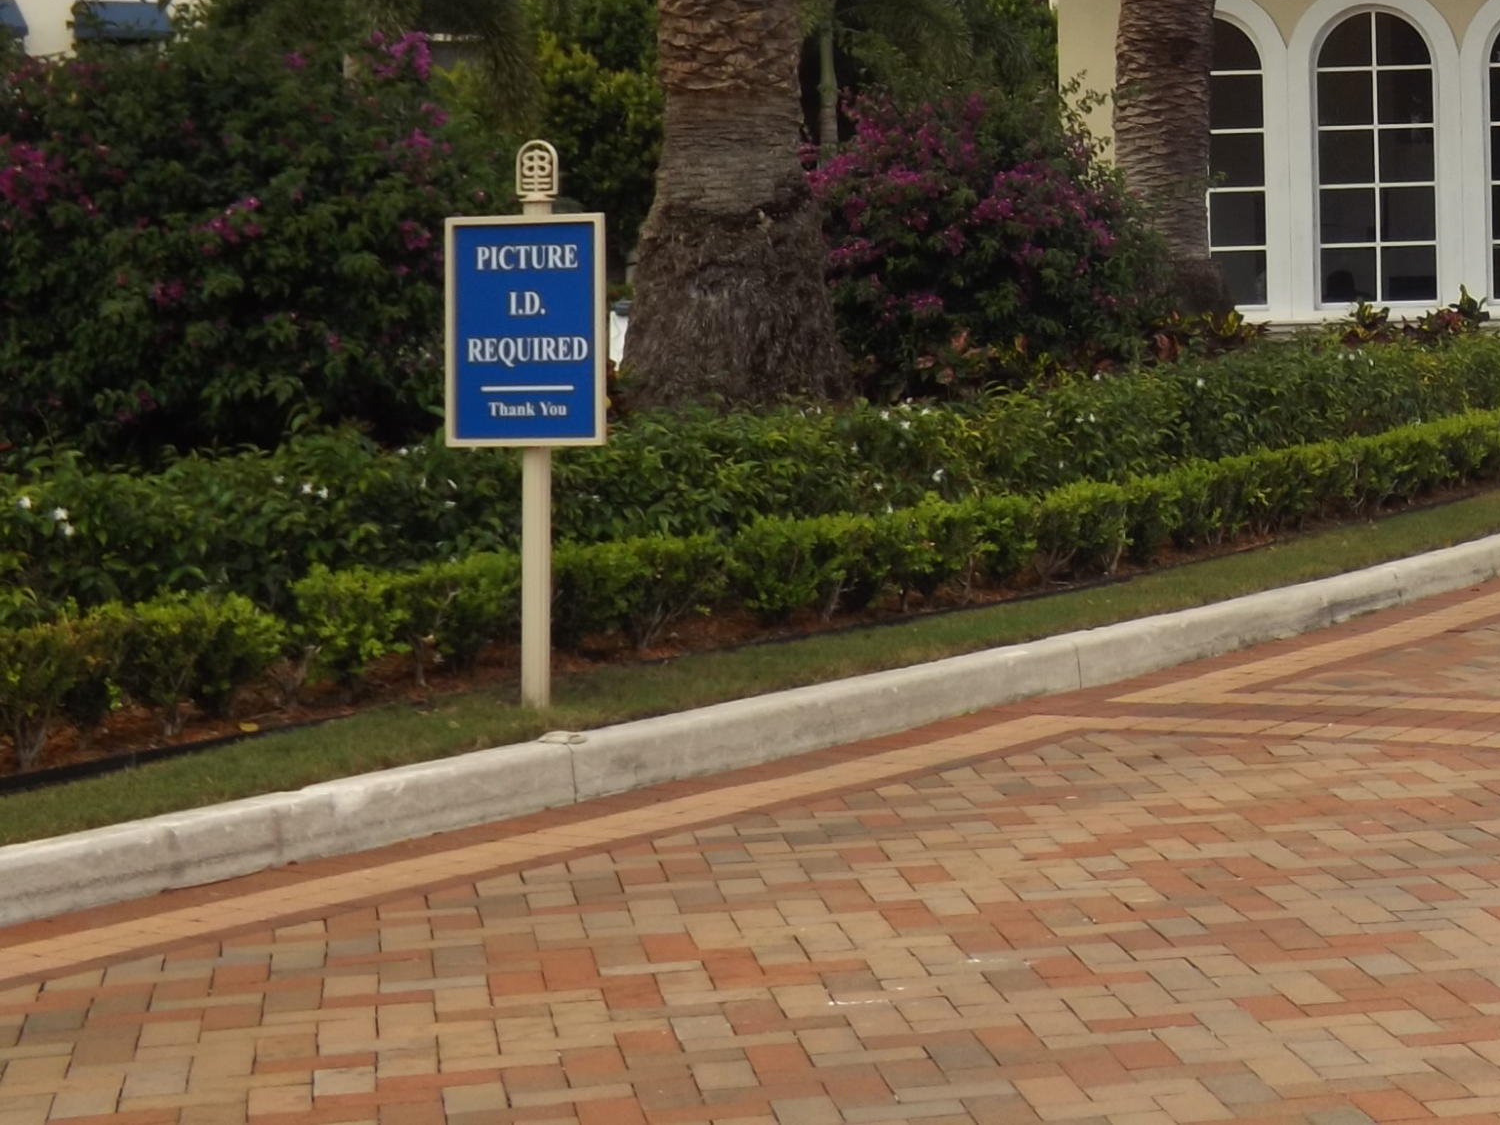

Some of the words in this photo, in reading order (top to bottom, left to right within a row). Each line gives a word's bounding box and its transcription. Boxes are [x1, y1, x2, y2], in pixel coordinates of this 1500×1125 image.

[476, 244, 578, 271] PICTURE
[509, 291, 546, 316] I.D.
[467, 336, 588, 367] REQUIRED
[488, 402, 536, 417] Thank
[539, 401, 567, 417] You
